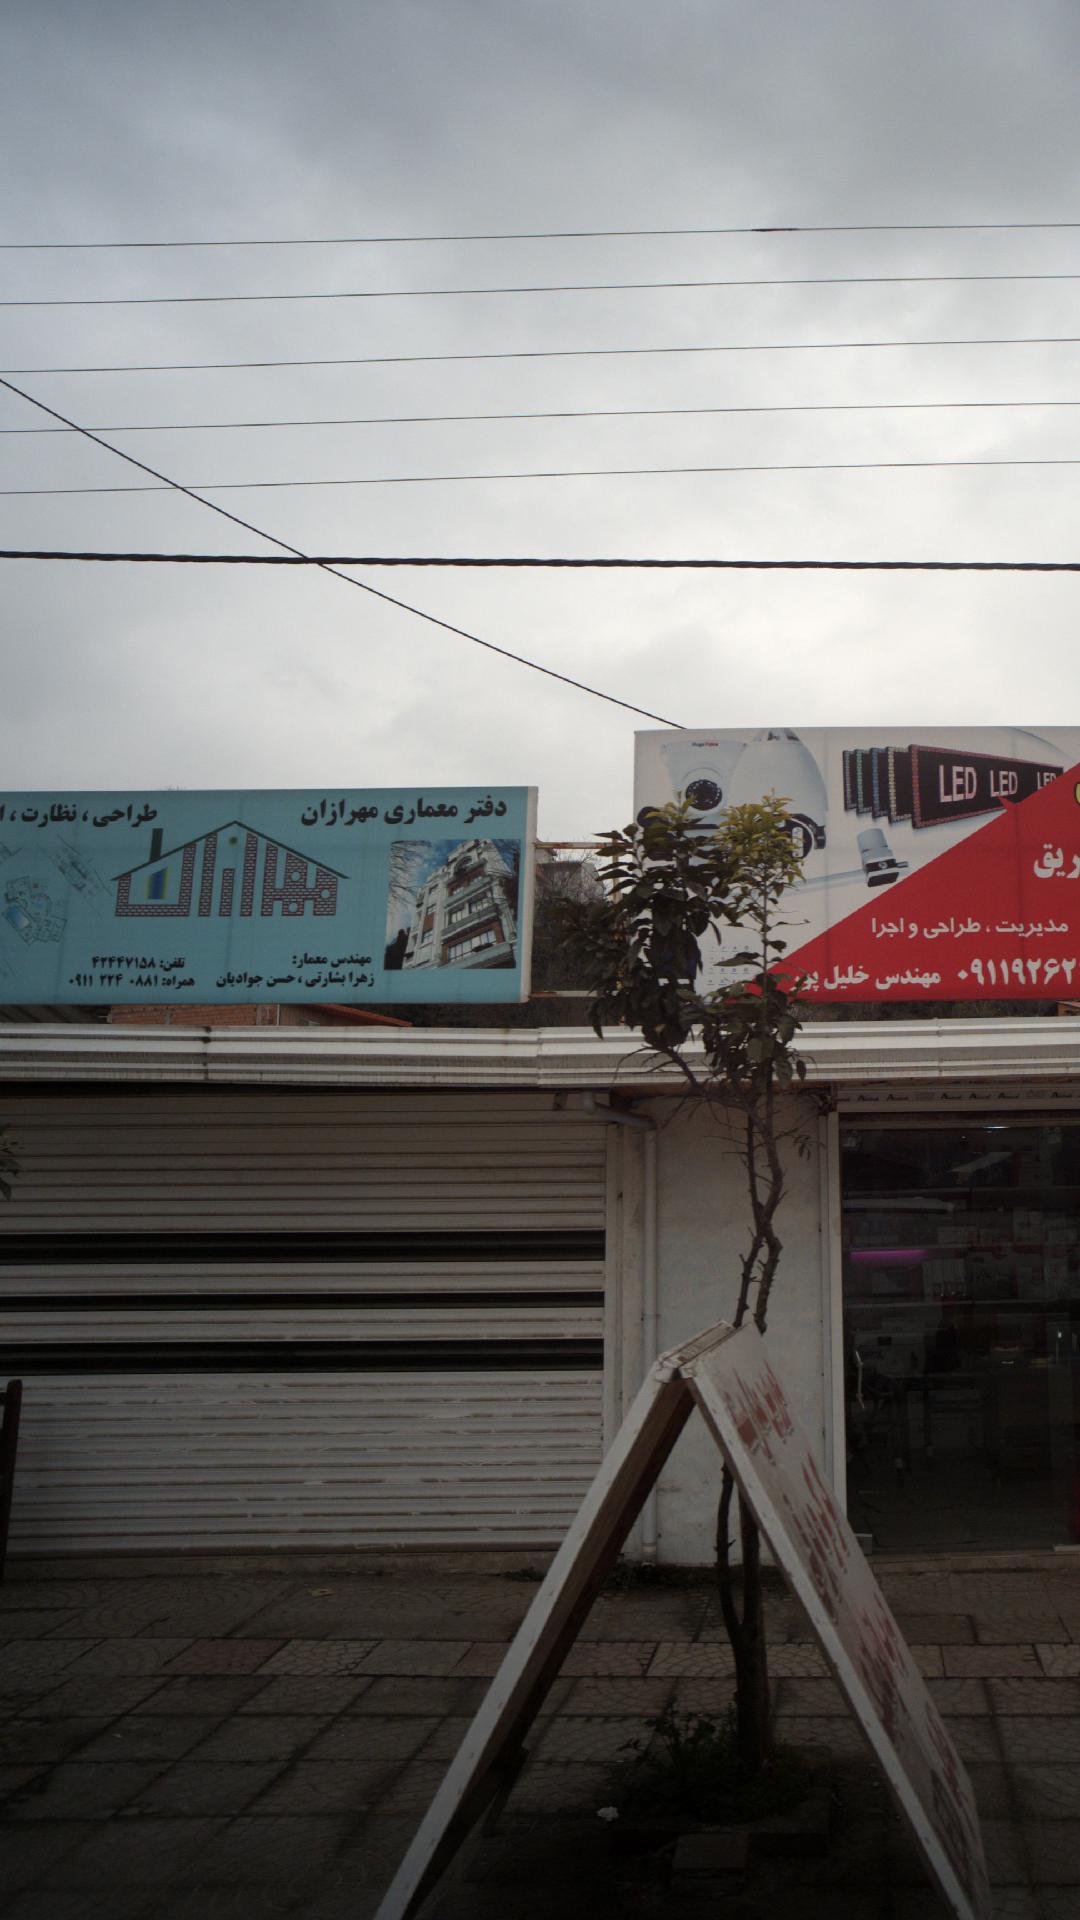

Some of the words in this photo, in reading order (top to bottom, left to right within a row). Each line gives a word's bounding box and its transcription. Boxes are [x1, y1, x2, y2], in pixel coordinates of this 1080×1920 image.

[938, 763, 977, 803] LED
[989, 768, 1020, 793] LED
[21, 803, 77, 828] نظارت
[92, 803, 158, 828] طراحی
[383, 797, 458, 825] معماری
[463, 795, 507, 824] دفتر
[871, 917, 905, 938] اجرا
[908, 922, 919, 939] و
[923, 917, 981, 939] طراحی
[995, 919, 1069, 938] مدیریت
[330, 953, 372, 969] مهندس
[957, 956, 1080, 986] ۰۹۱۱۹۲۶۲
[266, 975, 296, 988] حسن
[350, 971, 375, 988] زهرا
[823, 965, 870, 990] خلیل
[875, 967, 942, 990] مهندس
